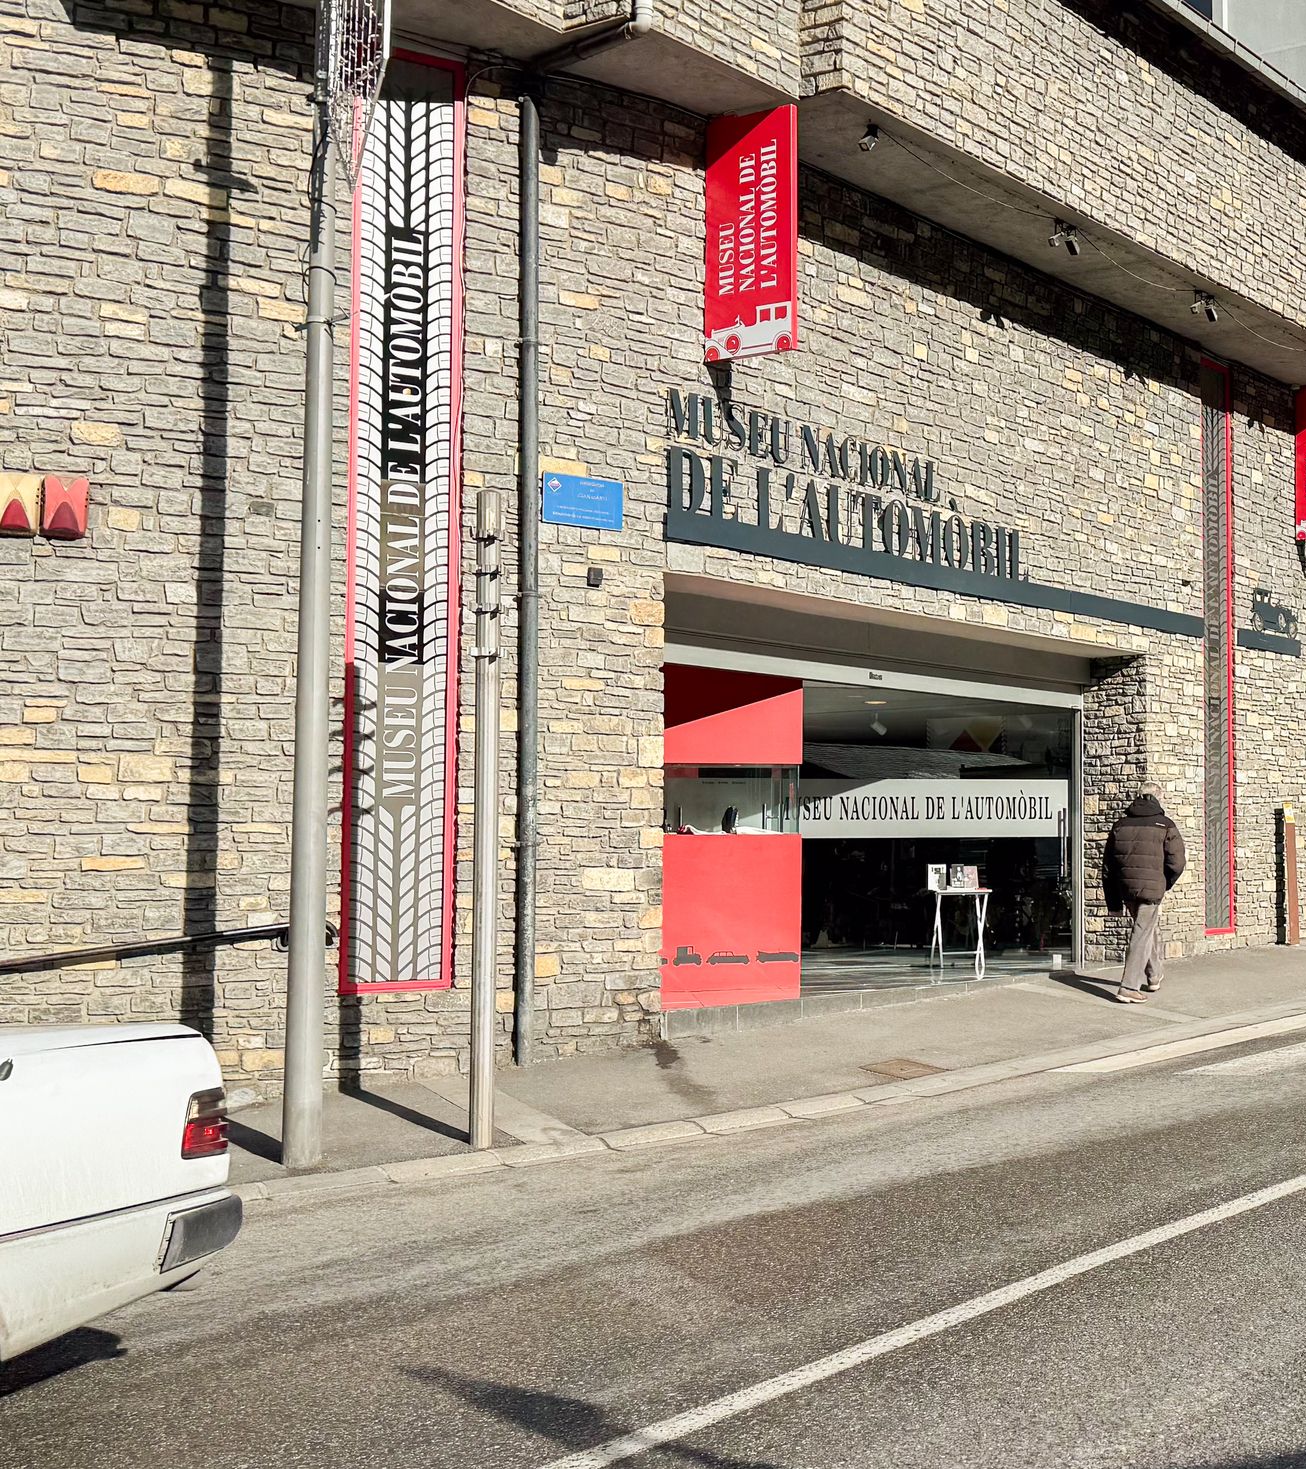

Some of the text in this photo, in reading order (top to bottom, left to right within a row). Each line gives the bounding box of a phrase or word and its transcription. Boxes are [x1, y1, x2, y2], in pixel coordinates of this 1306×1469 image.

[719, 222, 735, 296] MUSEU
[739, 153, 756, 292] NACIONAL DE
[756, 138, 777, 289] L'AUTOMÒBIL
[668, 388, 941, 502] MUSEU NACIONAL
[383, 230, 426, 799] MUSEU NACIONAL DE L'AUTOMÒBIL
[667, 446, 1030, 583] DE L'AUTOMÒBIL
[839, 796, 919, 820] NACIONAL
[925, 796, 945, 820] DE
[951, 789, 1053, 821] L'AUTOMÒBIL
